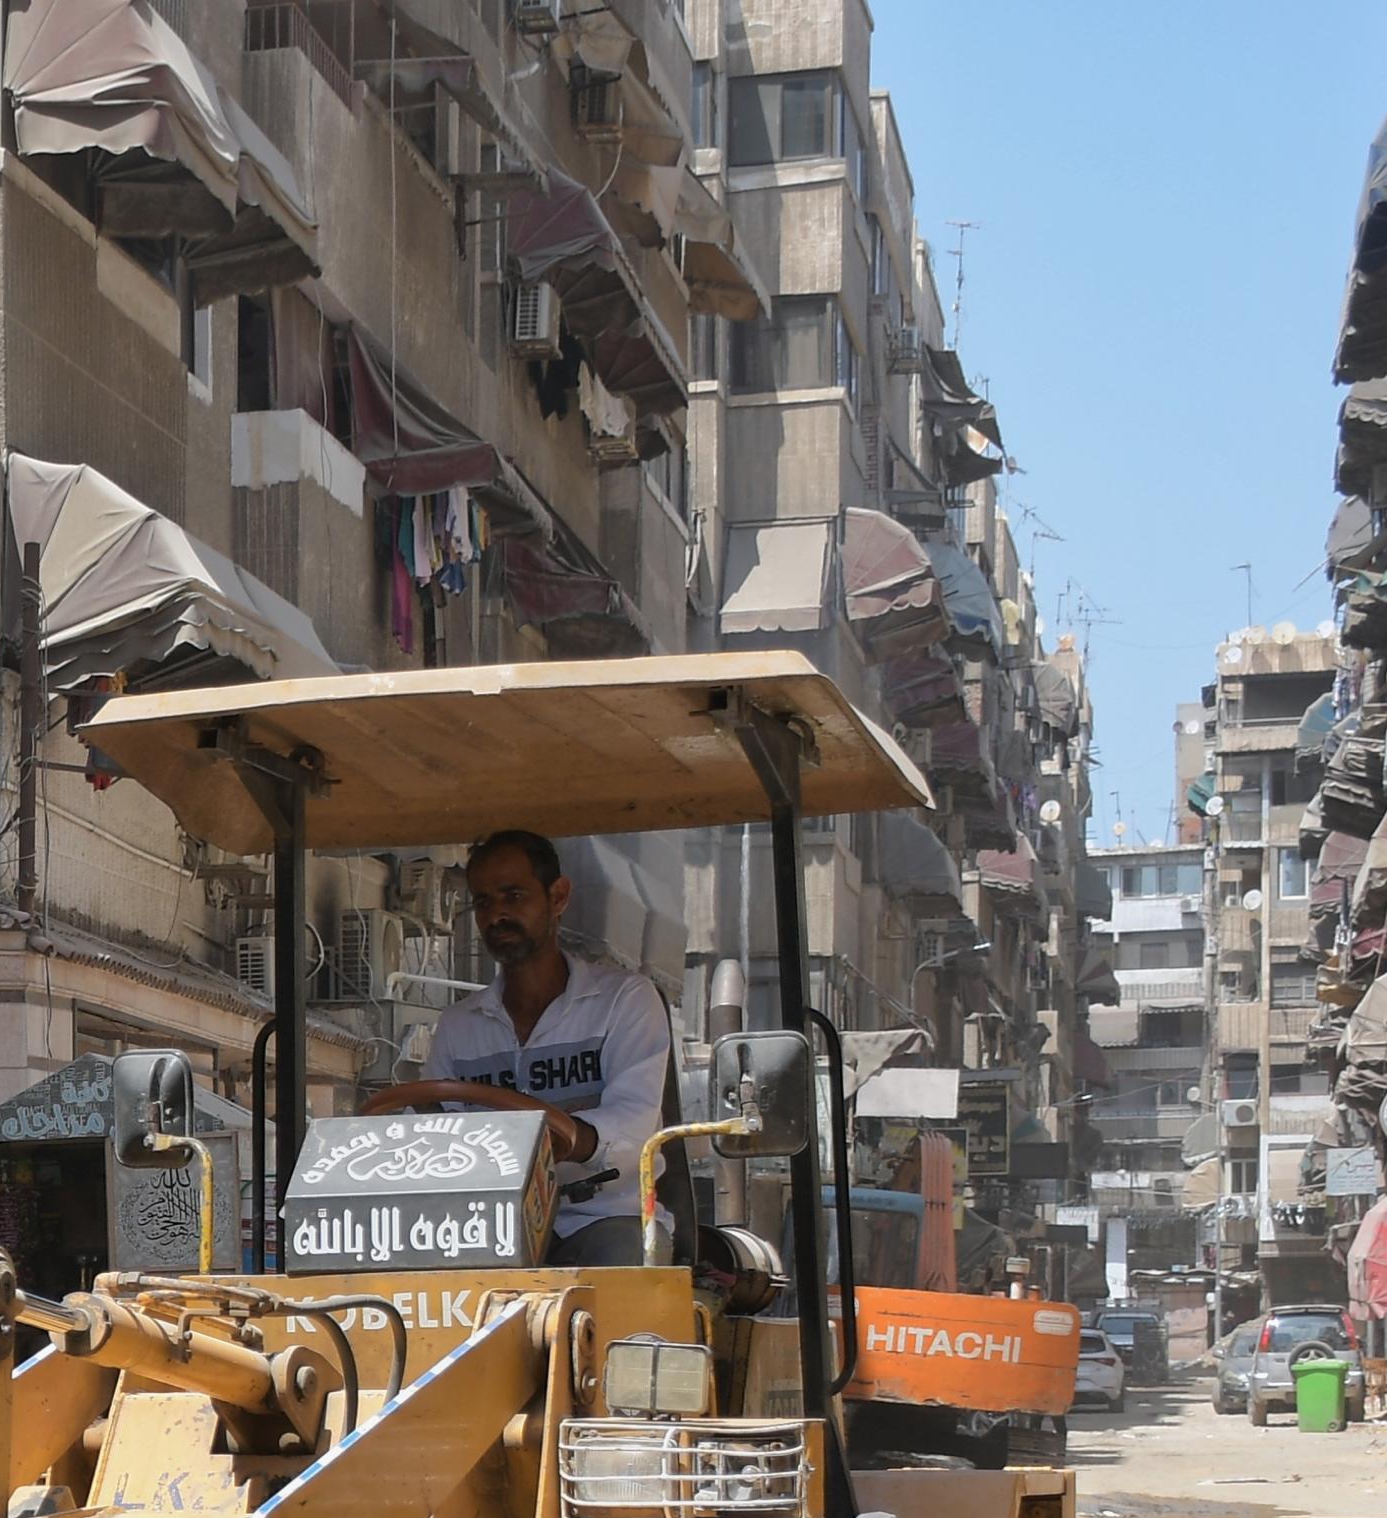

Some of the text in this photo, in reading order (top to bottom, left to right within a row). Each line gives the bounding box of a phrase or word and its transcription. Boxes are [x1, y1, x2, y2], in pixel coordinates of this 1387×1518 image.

[413, 1118, 463, 1136] الله
[293, 1208, 364, 1262] بالله
[494, 1201, 515, 1257] لا
[866, 1324, 1023, 1364] HITACHI
